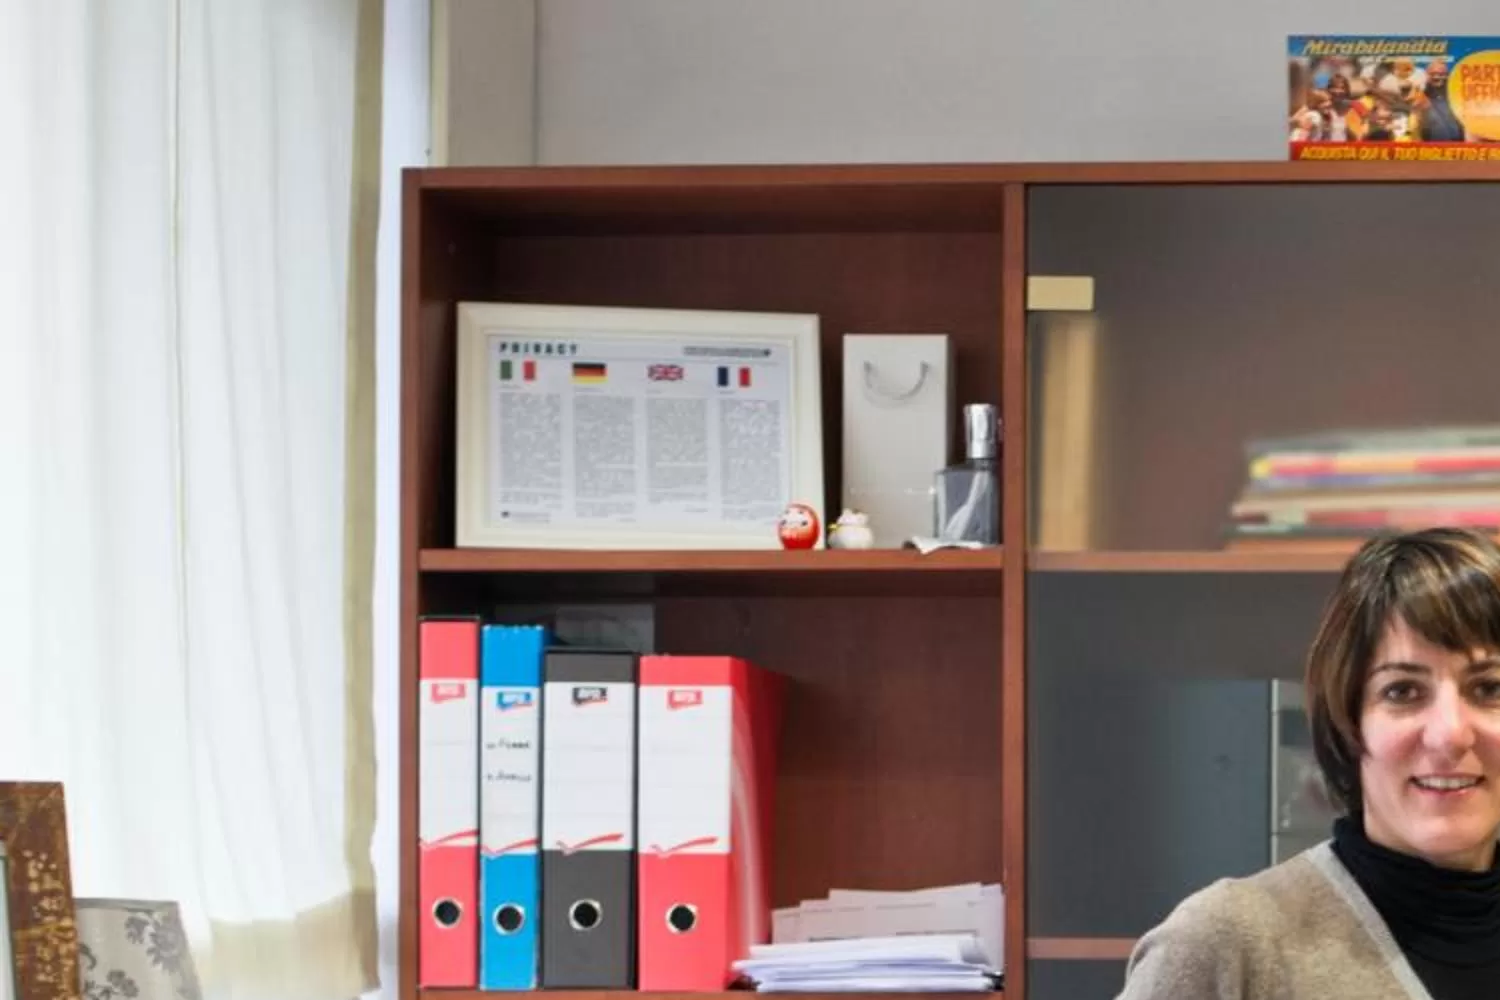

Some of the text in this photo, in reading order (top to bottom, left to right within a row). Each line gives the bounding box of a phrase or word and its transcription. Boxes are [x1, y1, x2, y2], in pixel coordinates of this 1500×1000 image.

[1302, 39, 1448, 55] Mirabilandia
[1300, 145, 1357, 160] ACQUISTA
[1418, 145, 1478, 160] BIGLIETTO
[499, 342, 578, 355] PRIVACY
